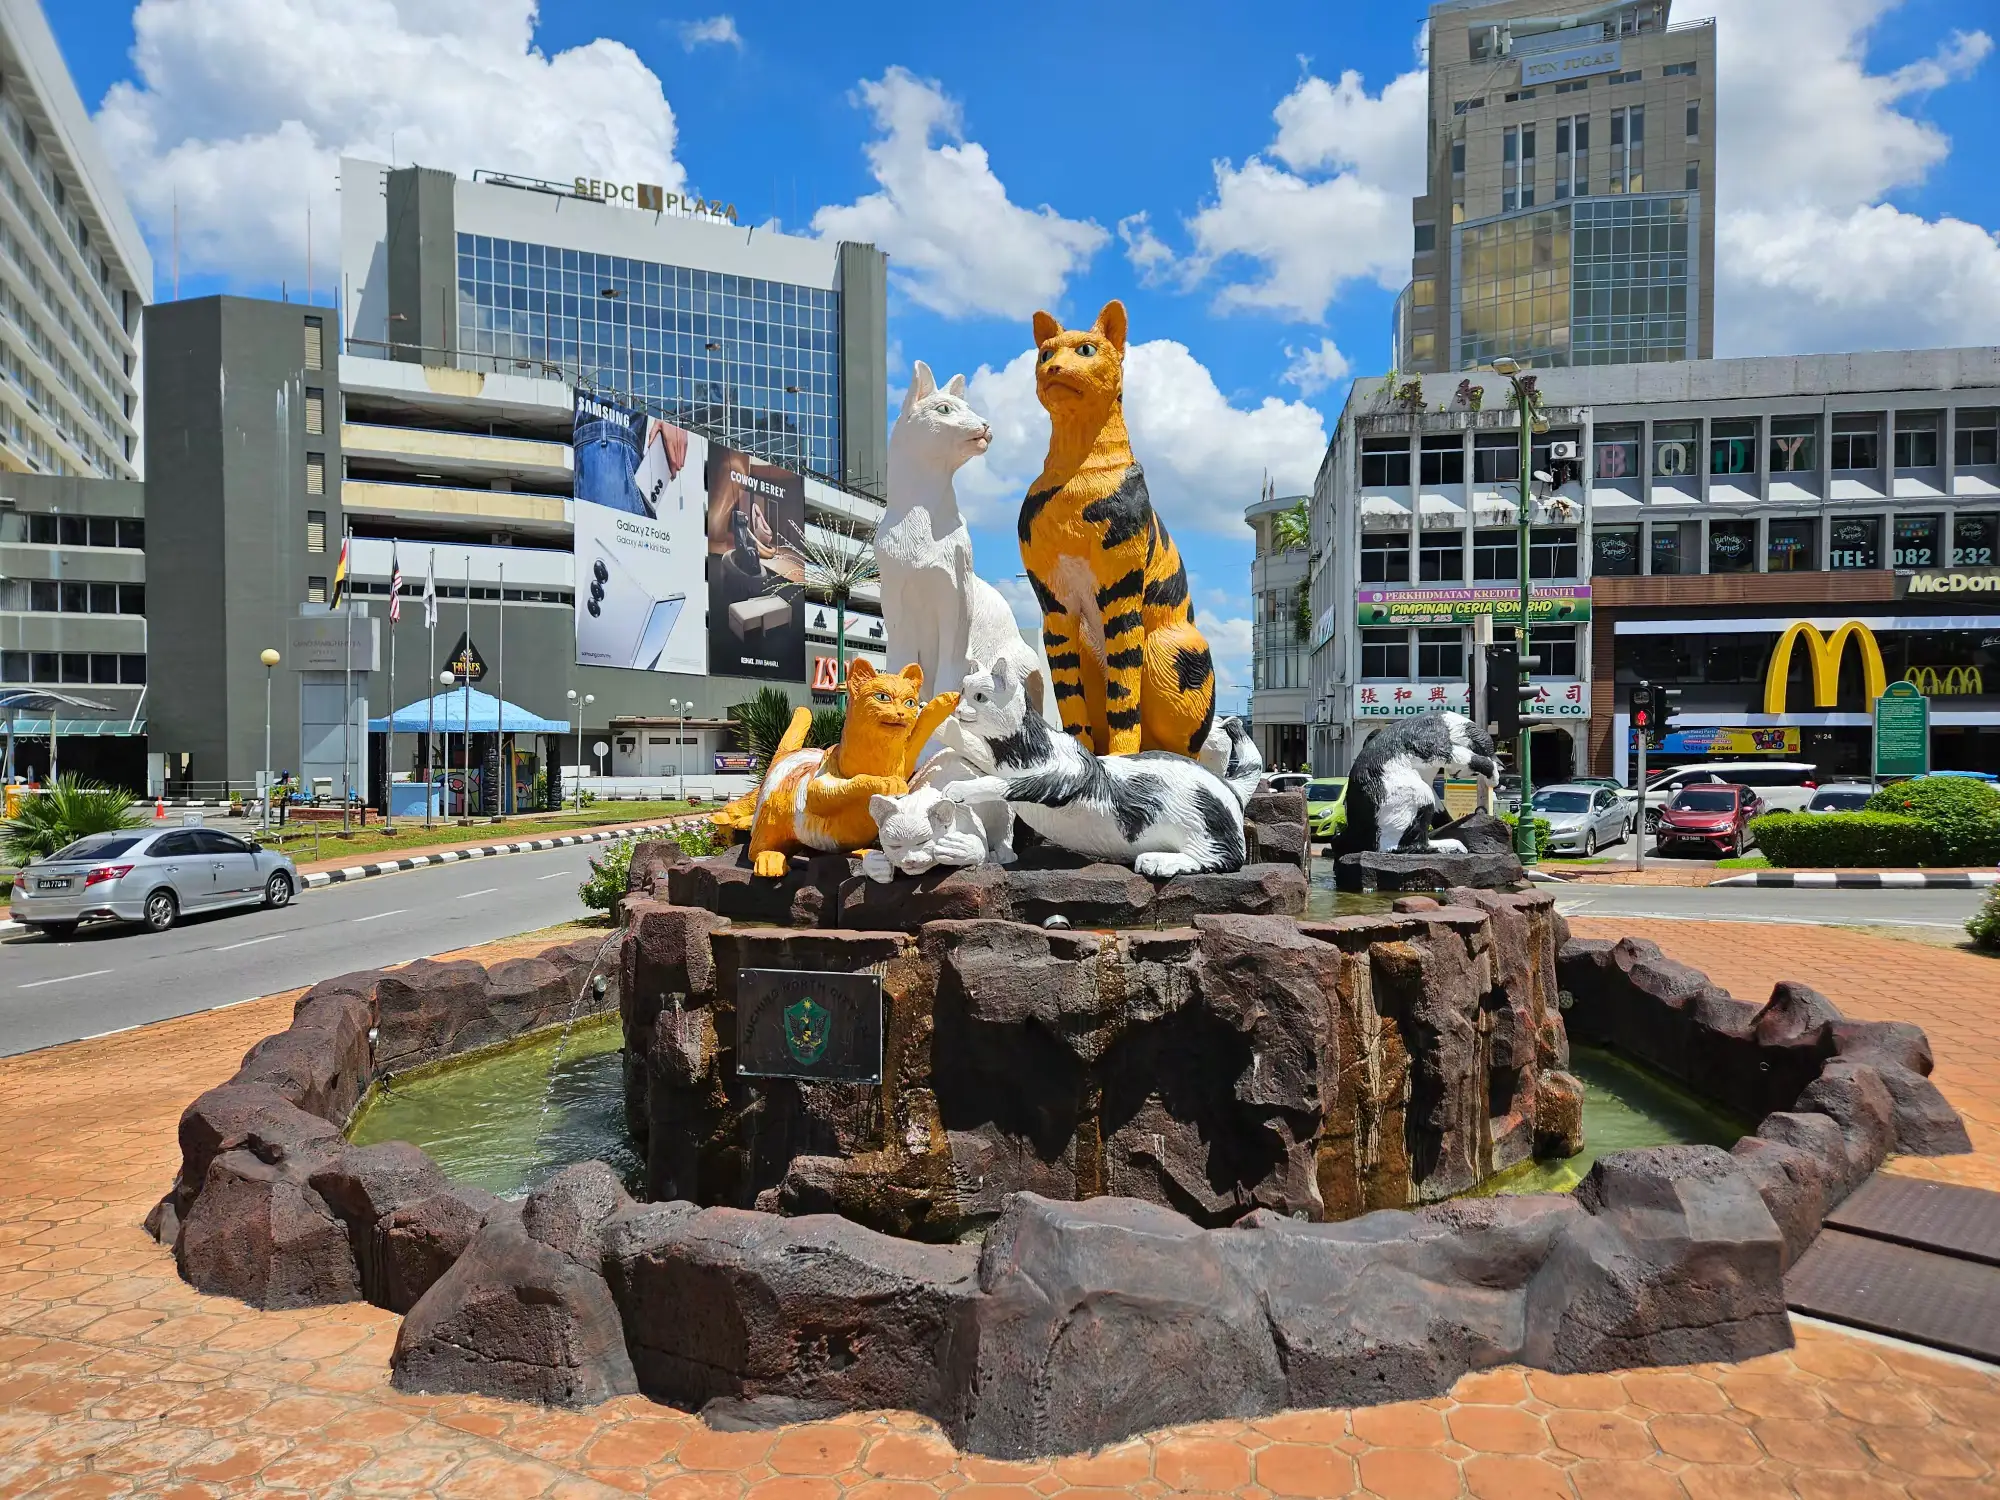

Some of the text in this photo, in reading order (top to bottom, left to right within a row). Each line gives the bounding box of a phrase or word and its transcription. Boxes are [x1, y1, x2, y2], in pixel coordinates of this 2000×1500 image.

[574, 177, 738, 220] SEDC PLAZA
[578, 396, 630, 428] SAMSUNG
[616, 519, 670, 541] Galaxy Z Fold6
[616, 535, 637, 548] Galaxy
[1601, 539, 1627, 549] Birthday
[1715, 535, 1741, 545] Birthday
[1603, 548, 1626, 556] Parties
[1716, 544, 1740, 552] Parties
[1830, 548, 1991, 567] TEL: 082 232
[1908, 574, 2000, 593] McDon
[1386, 590, 1471, 600] PERKHIDMATAN
[1474, 589, 1516, 598] KREDIT
[1391, 600, 1553, 615] PIMPINAN CERIA SDN BHD
[1361, 706, 1389, 715] TEO
[1560, 705, 1585, 714] CO.
[782, 980, 826, 992] NORTH
